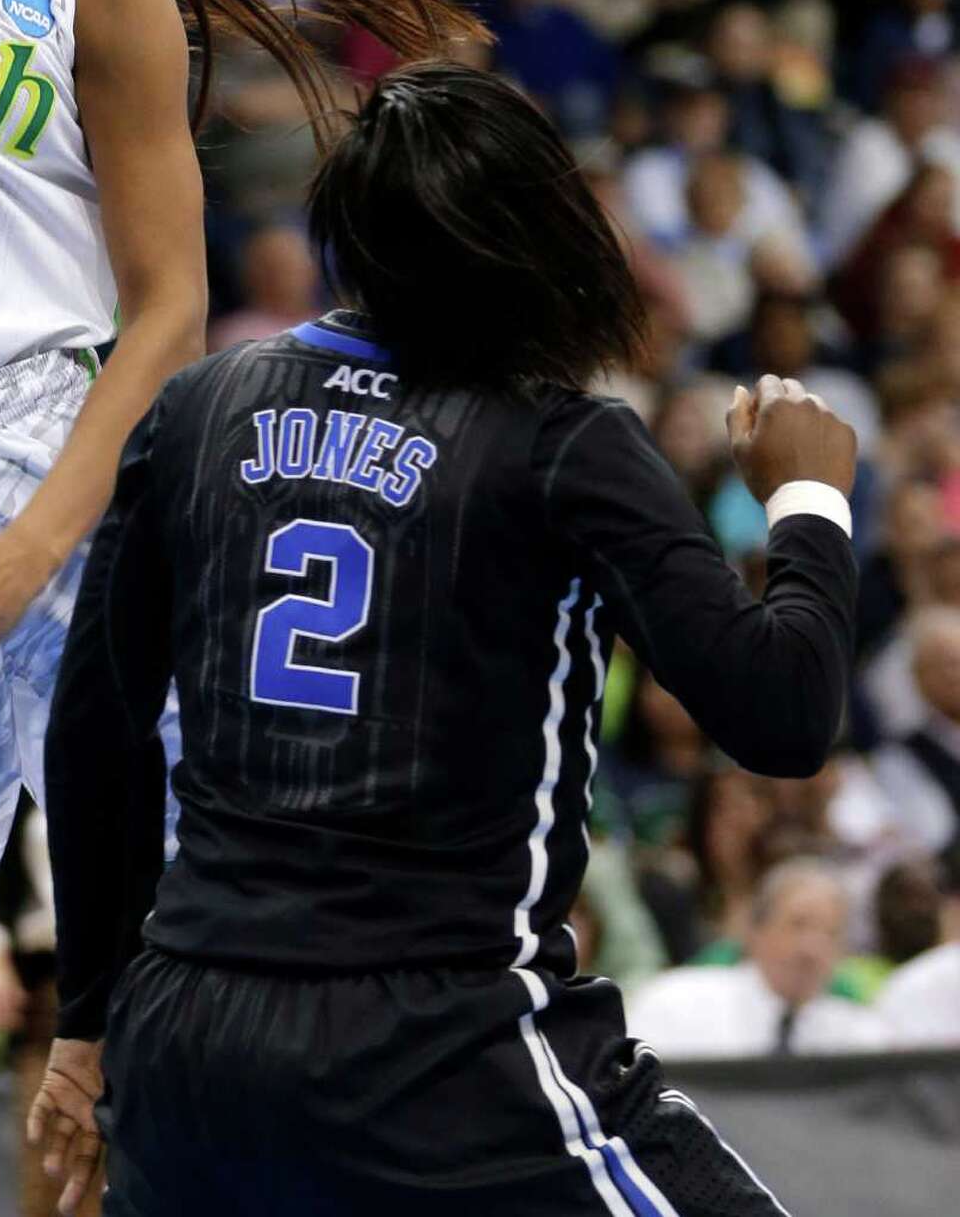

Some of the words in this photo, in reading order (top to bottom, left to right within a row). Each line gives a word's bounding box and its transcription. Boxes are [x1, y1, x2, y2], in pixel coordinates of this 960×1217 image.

[8, 0, 52, 31] NCAA
[323, 364, 399, 401] ACC
[240, 407, 438, 508] JONES
[249, 517, 375, 717] 2
